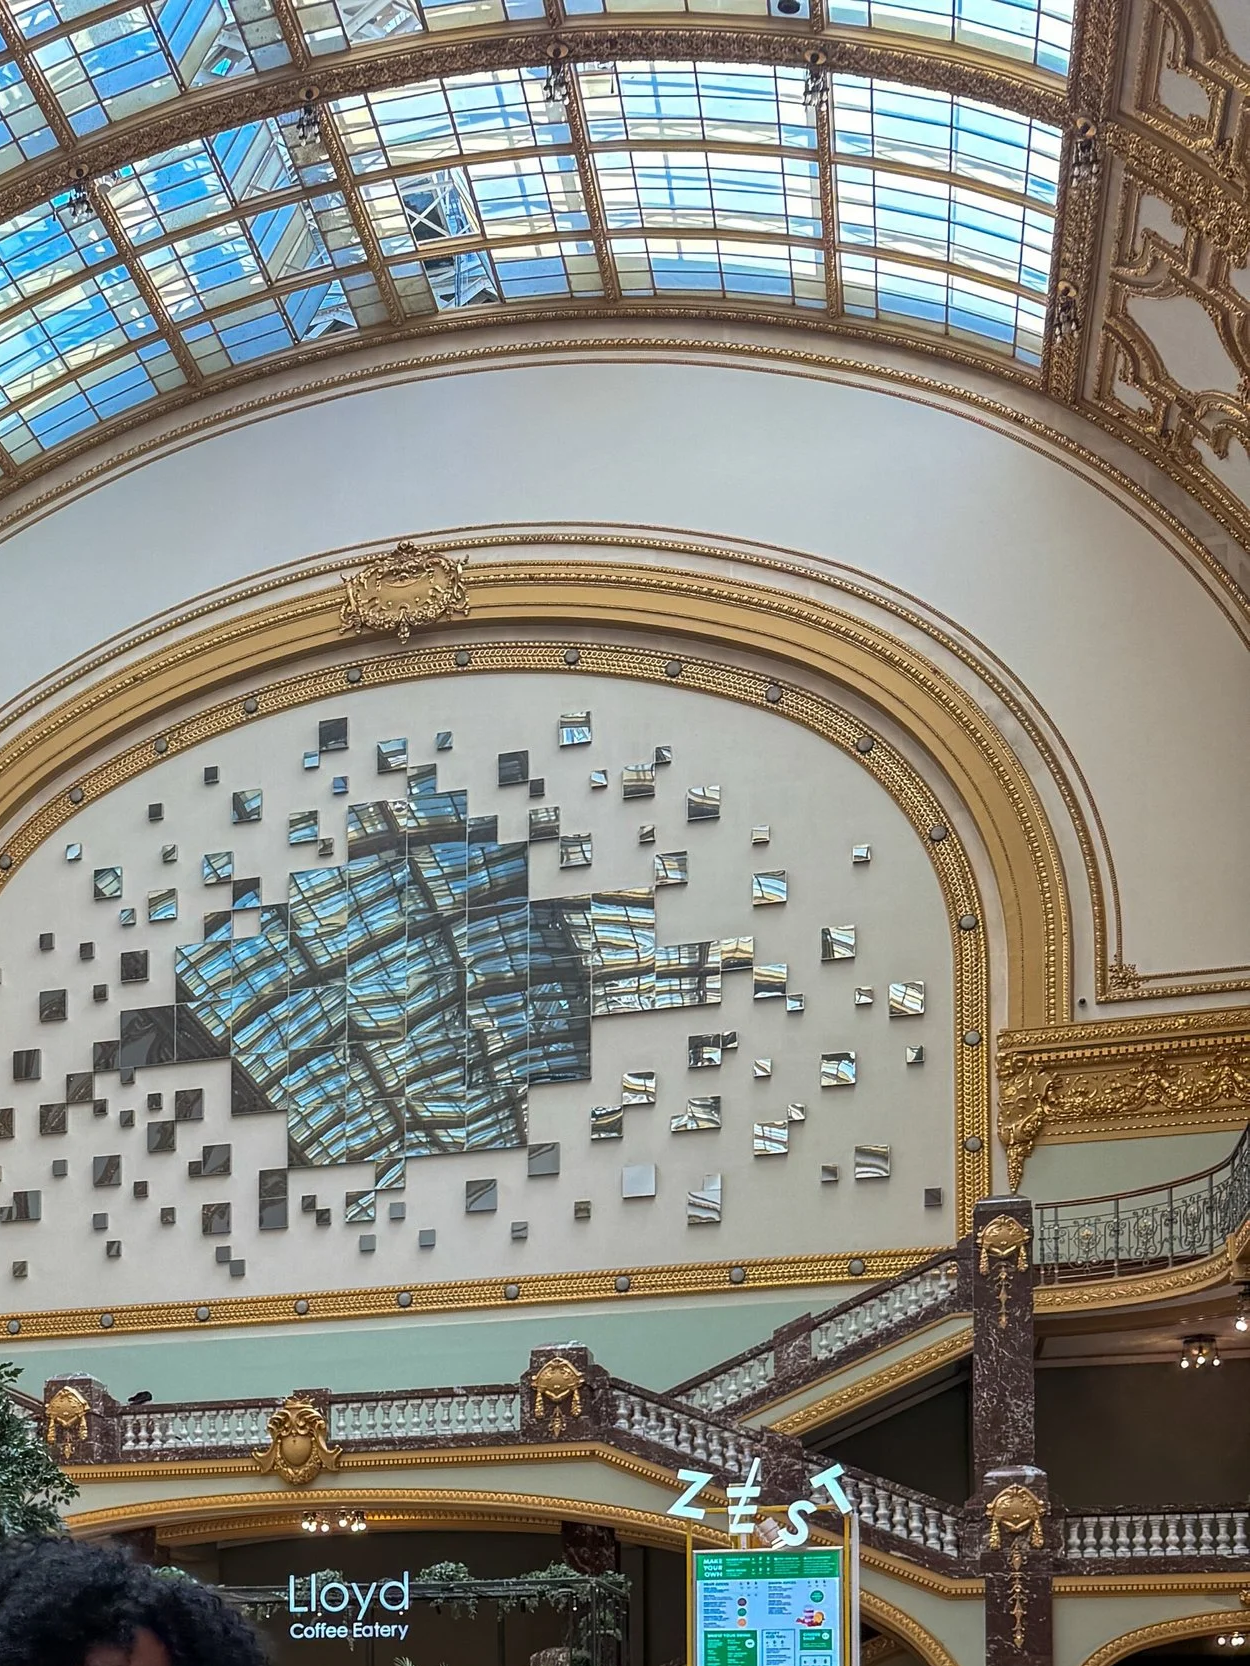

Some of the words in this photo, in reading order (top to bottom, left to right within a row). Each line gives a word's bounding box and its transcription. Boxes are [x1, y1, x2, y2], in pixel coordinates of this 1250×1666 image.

[288, 1571, 410, 1620] Lloyd
[289, 1623, 349, 1639] Coffee
[352, 1622, 409, 1640] Eatery
